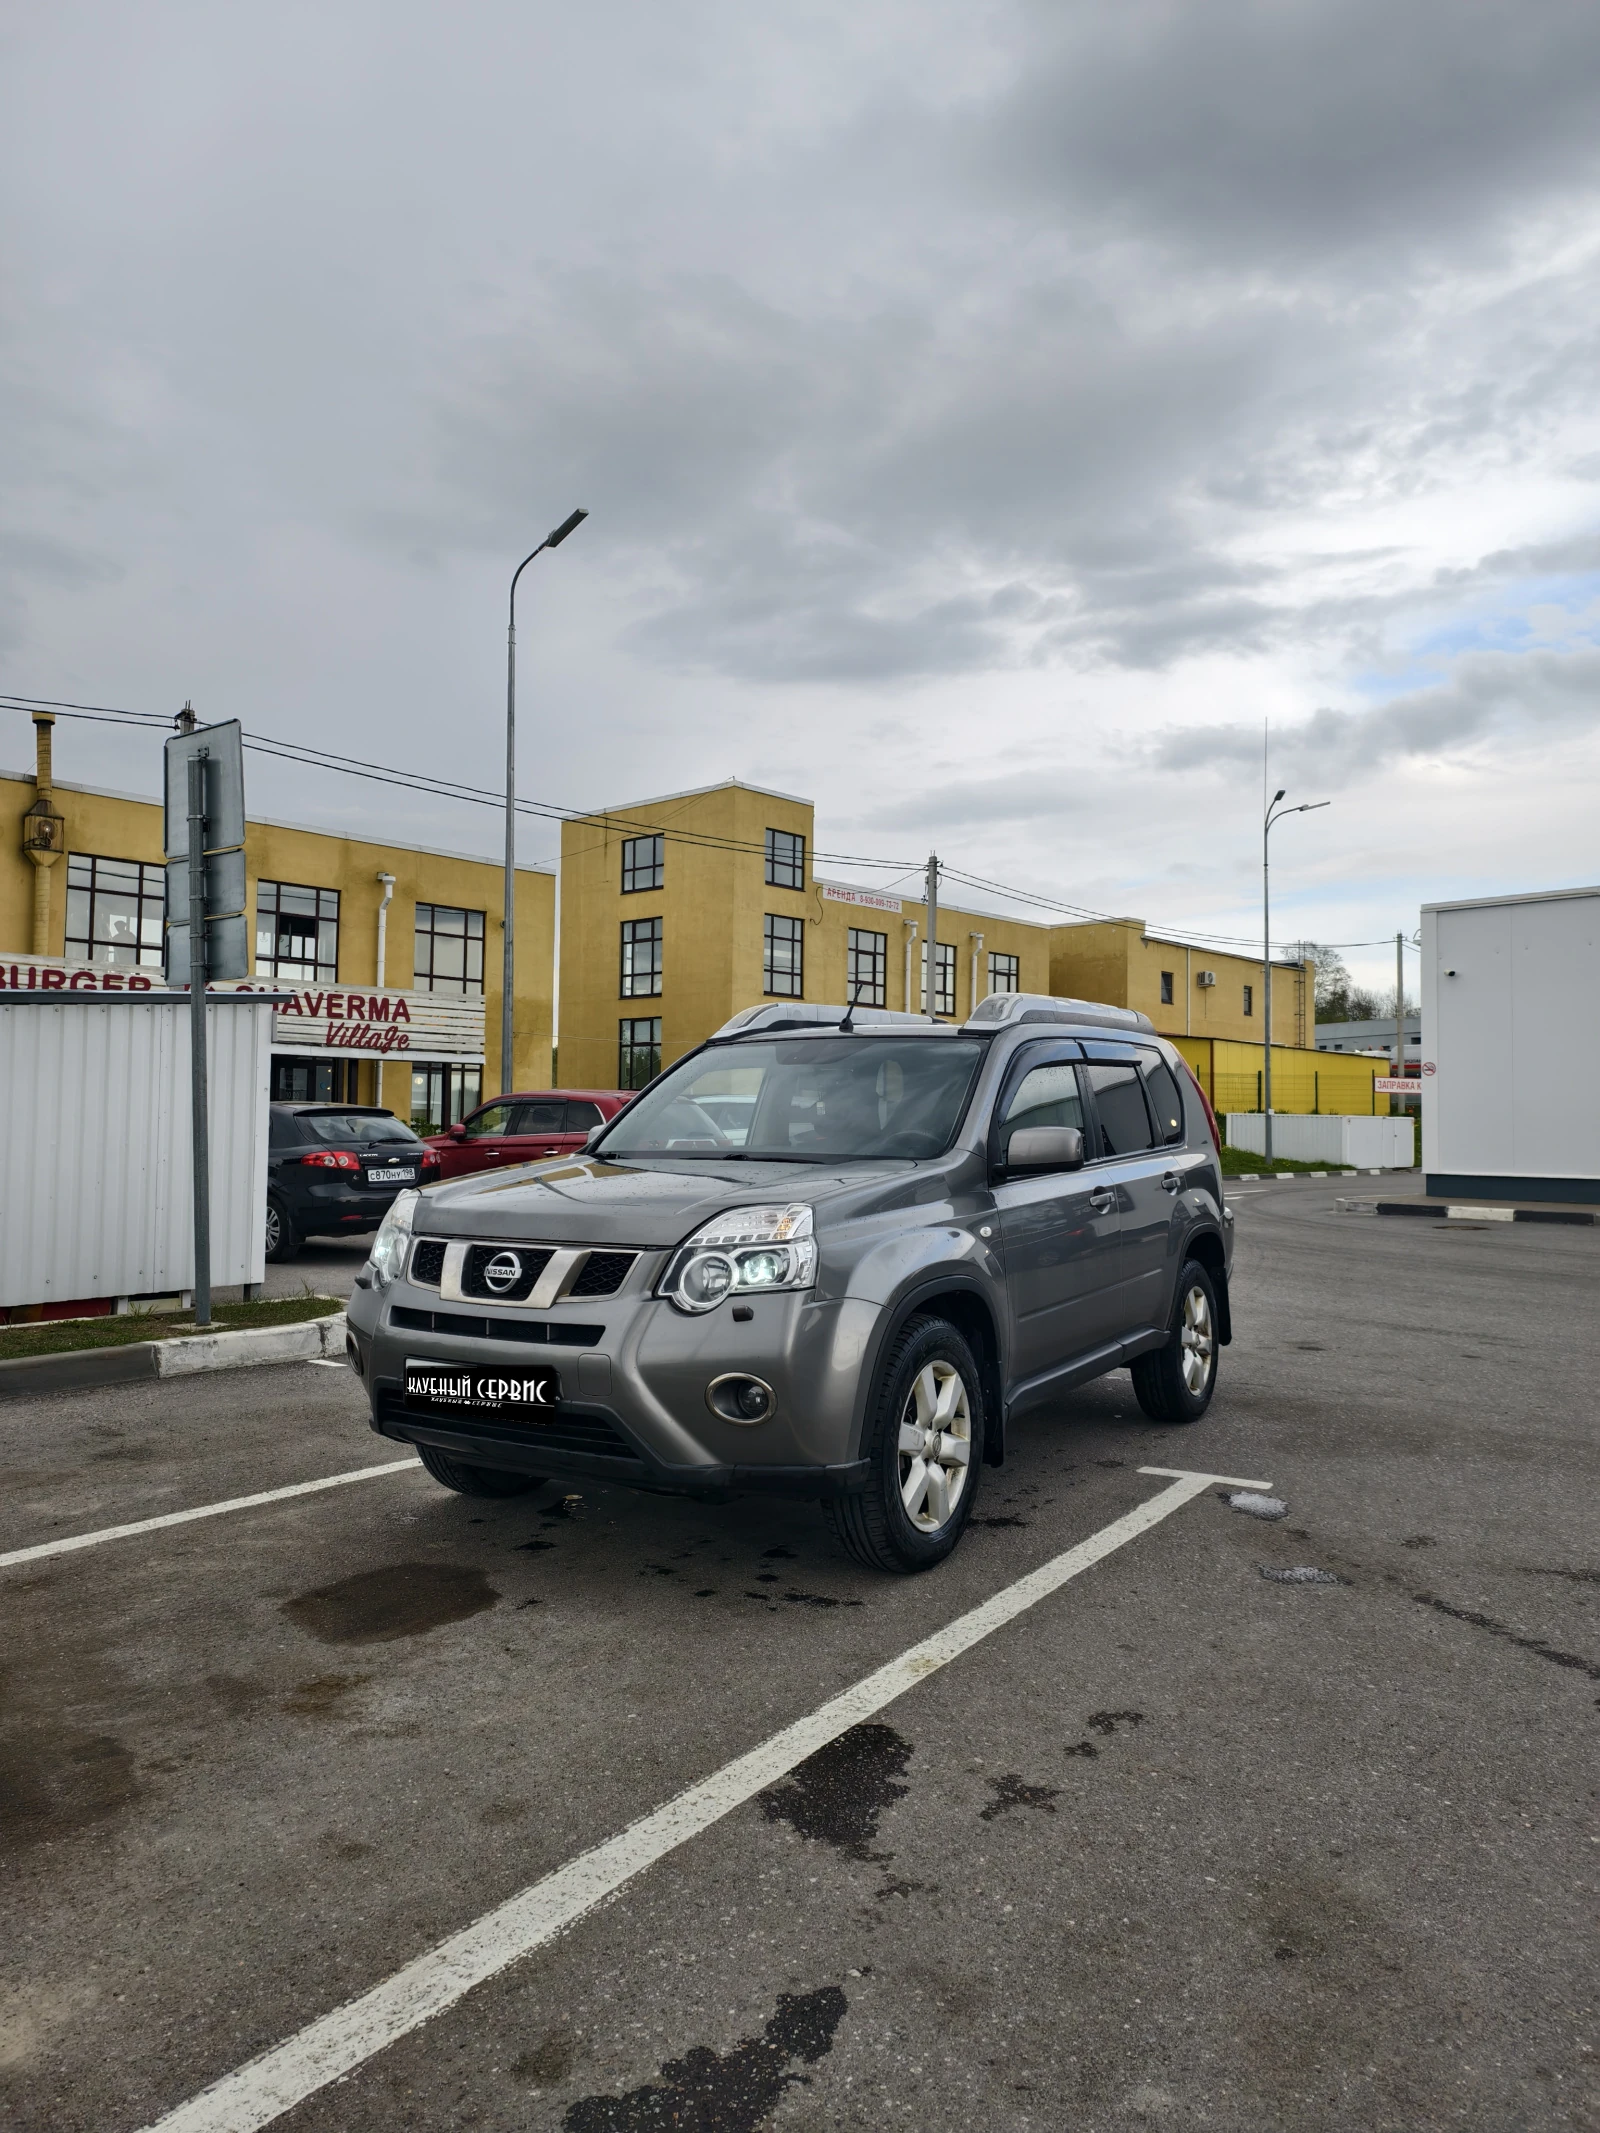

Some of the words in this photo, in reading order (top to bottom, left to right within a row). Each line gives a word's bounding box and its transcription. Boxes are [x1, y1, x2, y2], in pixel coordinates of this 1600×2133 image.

[827, 888, 856, 902] АРЕНДА
[0, 965, 151, 990] URGER
[236, 985, 411, 1023] AVERMA
[326, 1021, 410, 1054] Village
[1377, 1080, 1415, 1090] ЗАПРАВКА
[486, 1268, 516, 1277] NISSAN
